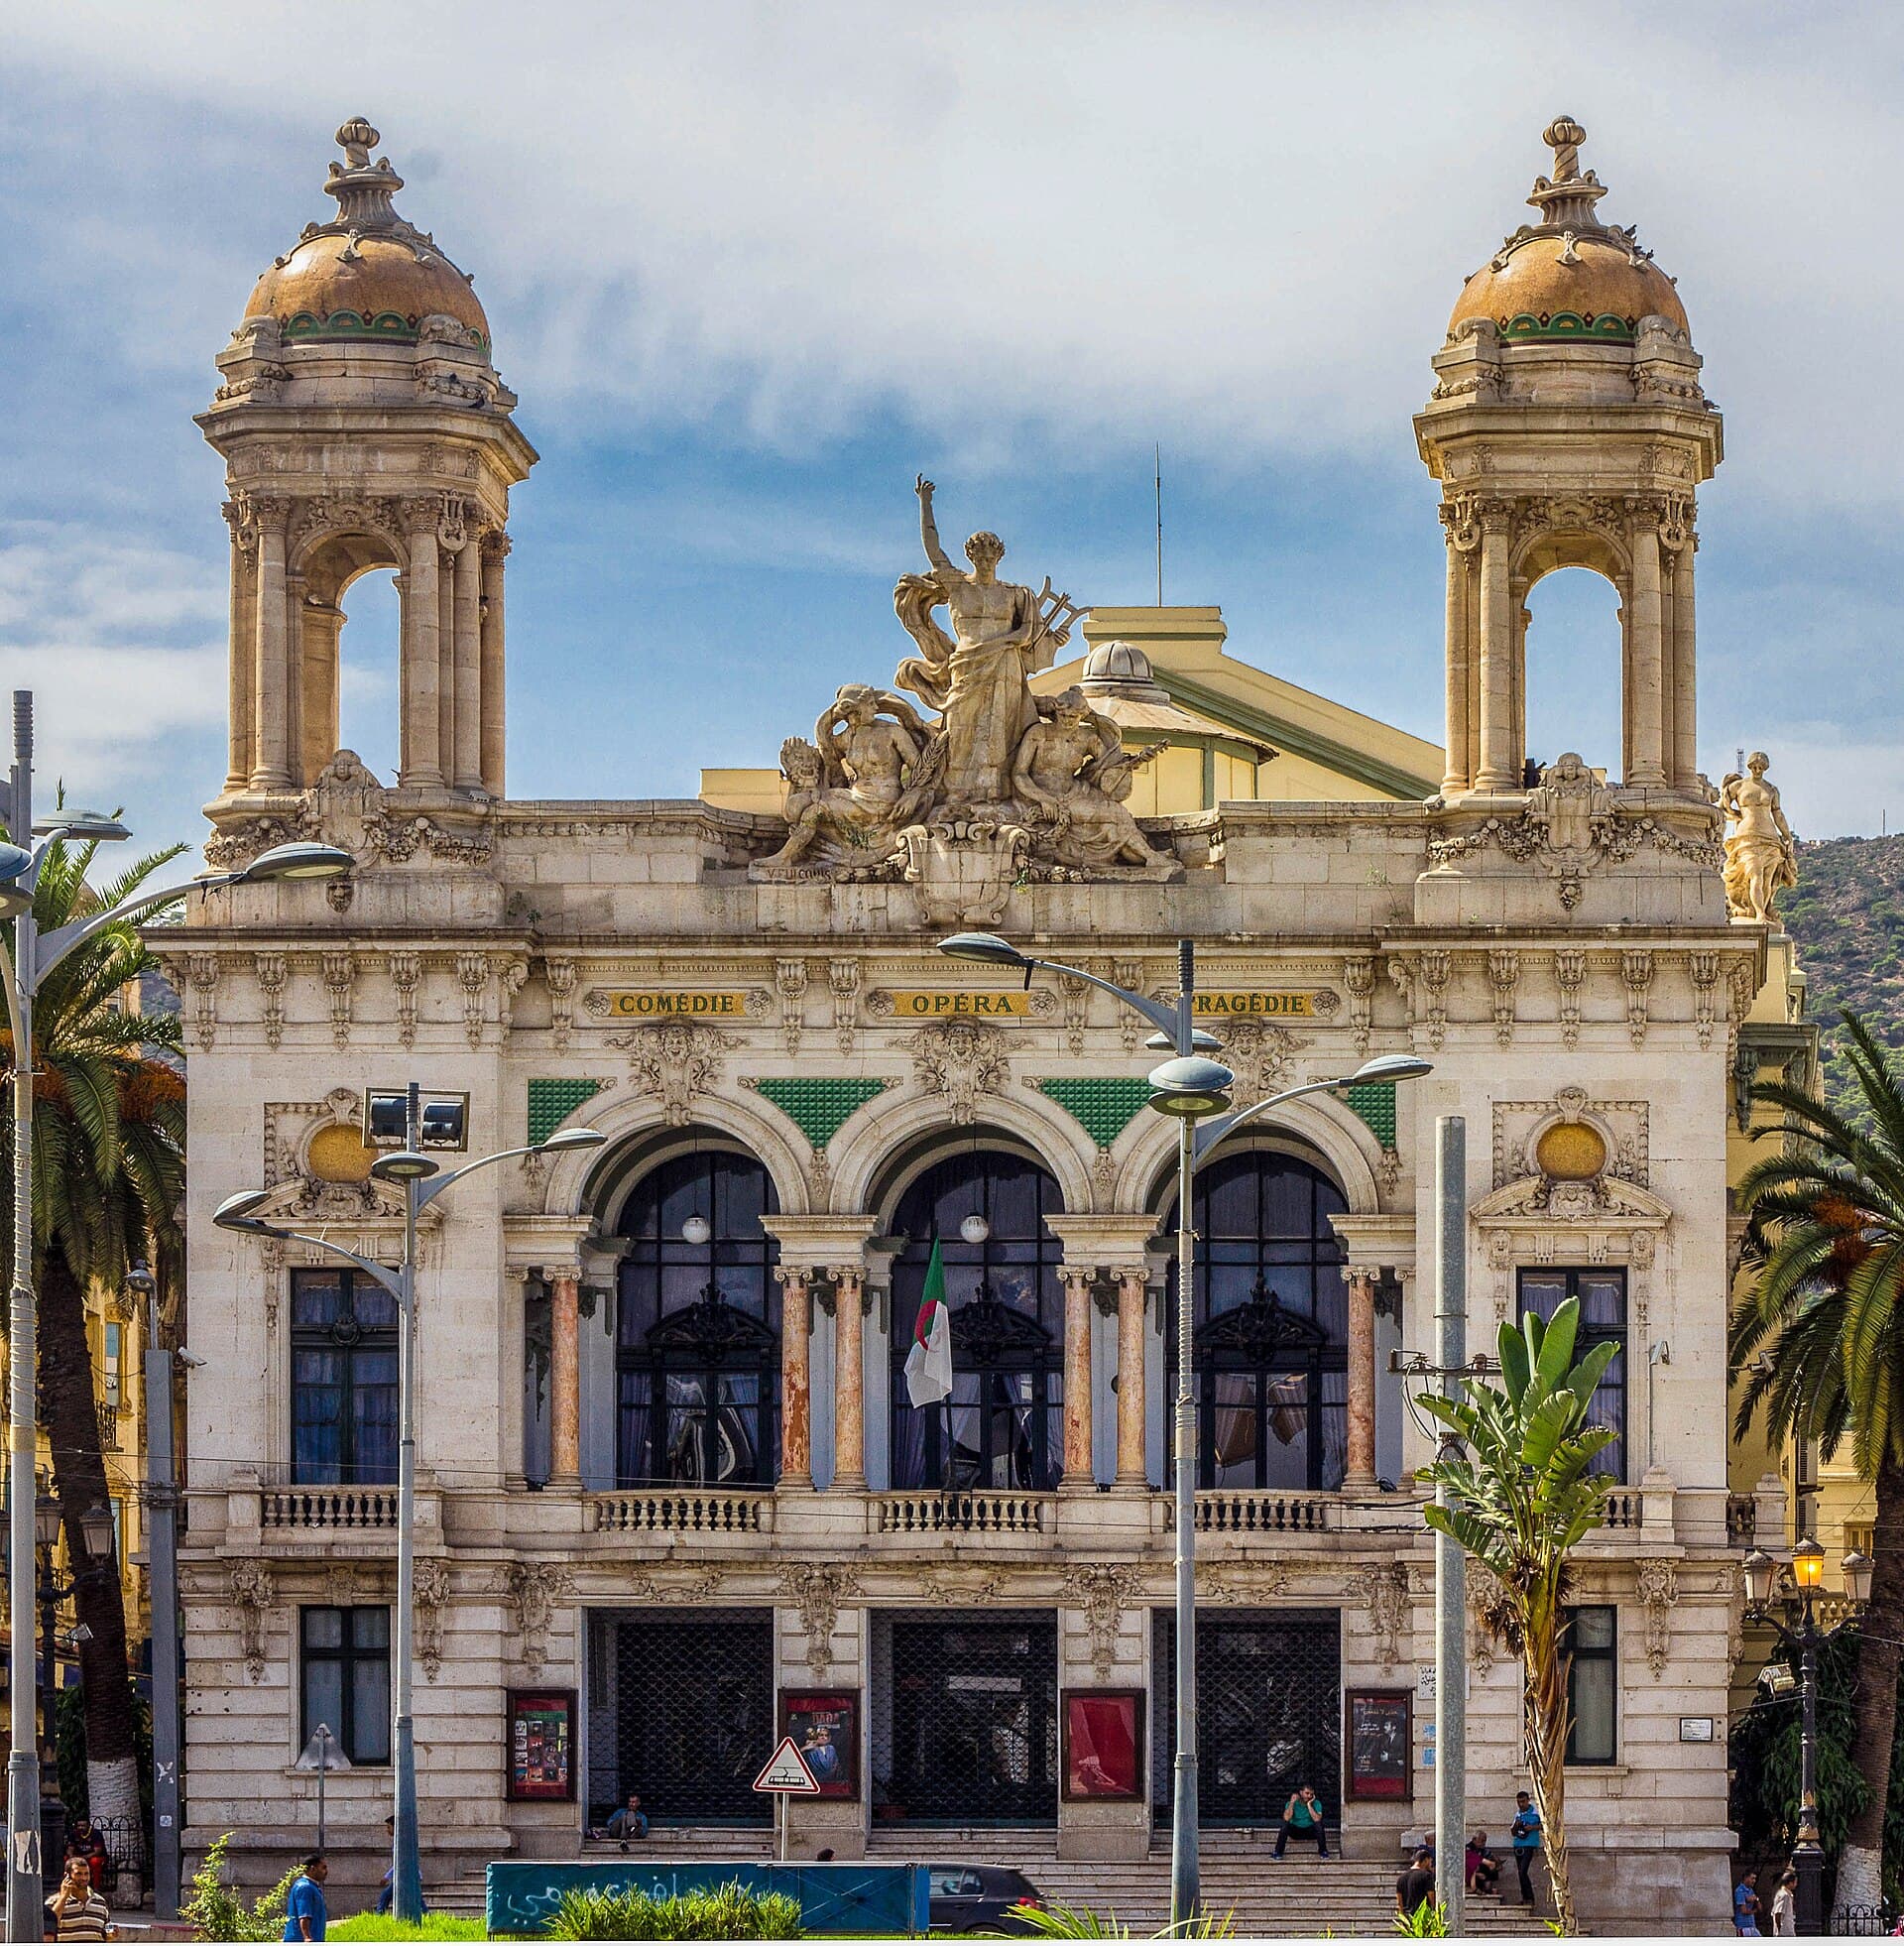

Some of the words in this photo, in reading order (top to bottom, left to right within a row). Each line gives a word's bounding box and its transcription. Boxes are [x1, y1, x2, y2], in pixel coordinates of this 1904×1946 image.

[619, 993, 734, 1013] COMÉDIE
[912, 993, 1013, 1013] OPÉRA
[1191, 993, 1304, 1013] RAGÉDIE
